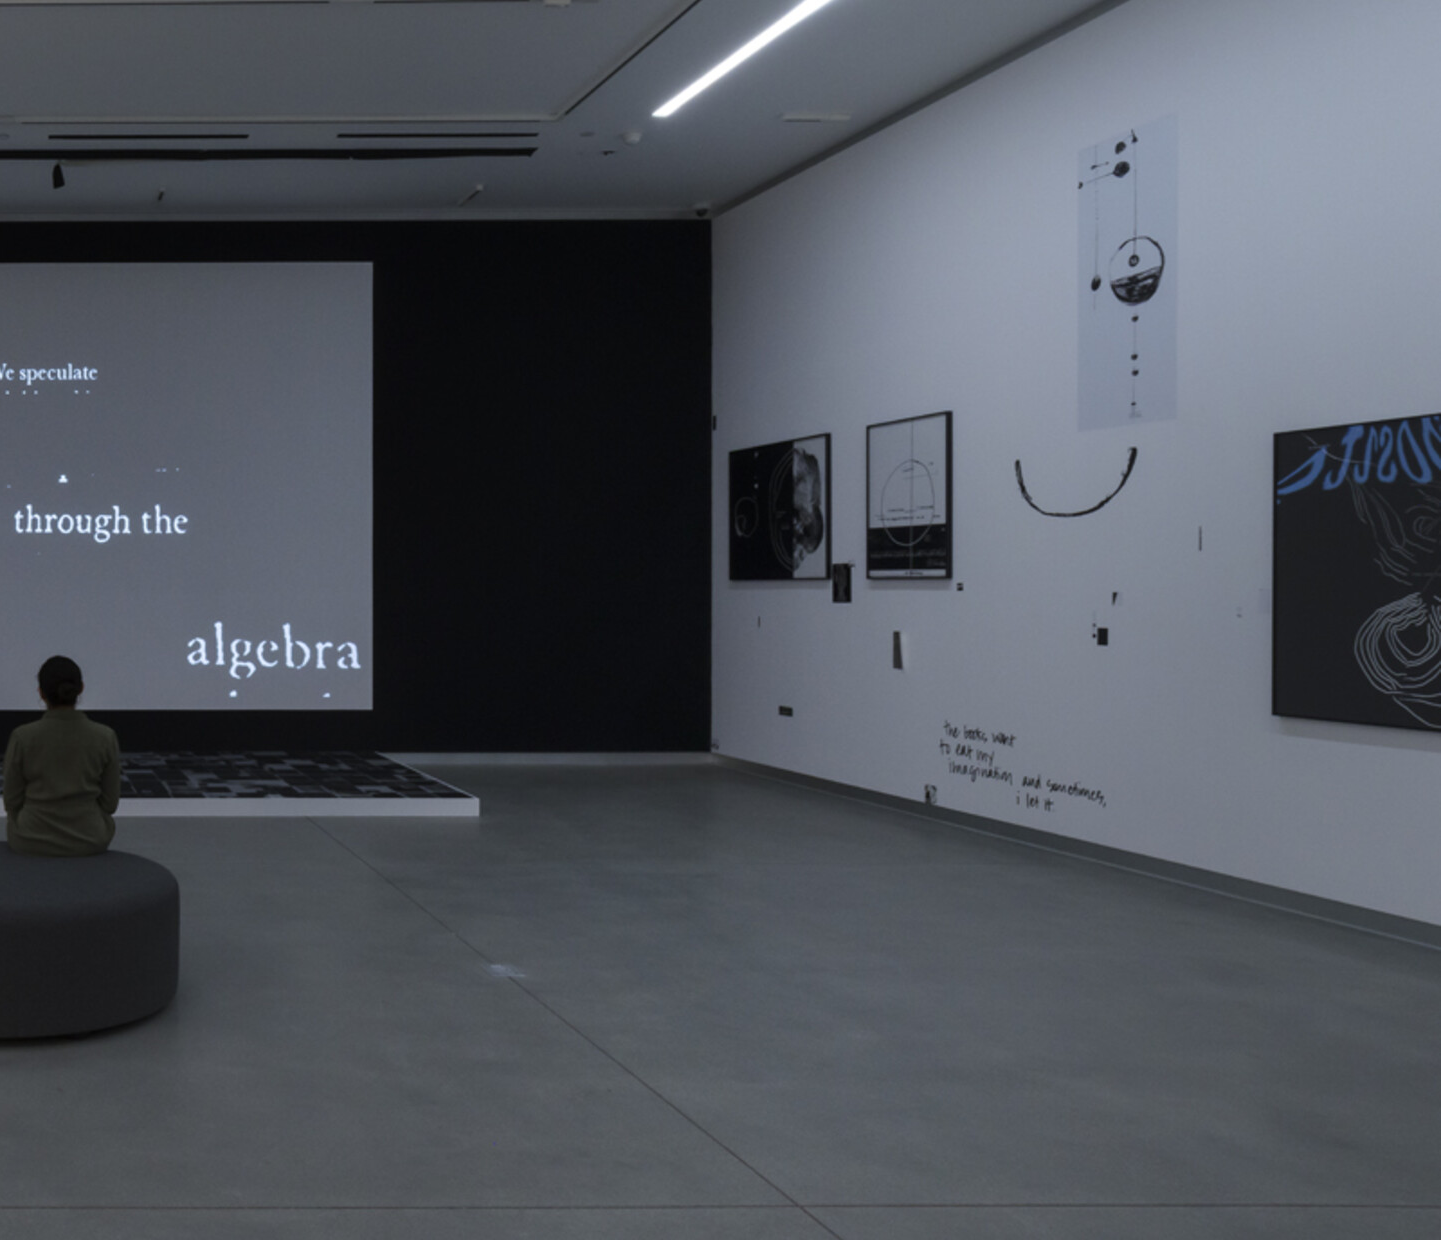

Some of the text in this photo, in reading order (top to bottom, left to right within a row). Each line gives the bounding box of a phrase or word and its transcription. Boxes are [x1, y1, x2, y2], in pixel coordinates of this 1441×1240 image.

[18, 362, 99, 387] speculate
[14, 504, 132, 544] through
[141, 503, 189, 535] the
[186, 621, 362, 680] algebra
[943, 720, 959, 739] the
[991, 733, 1016, 747] want
[939, 739, 995, 766] to eat my
[948, 758, 1014, 786] imagination
[1022, 774, 1042, 790] and
[1026, 794, 1040, 809] let
